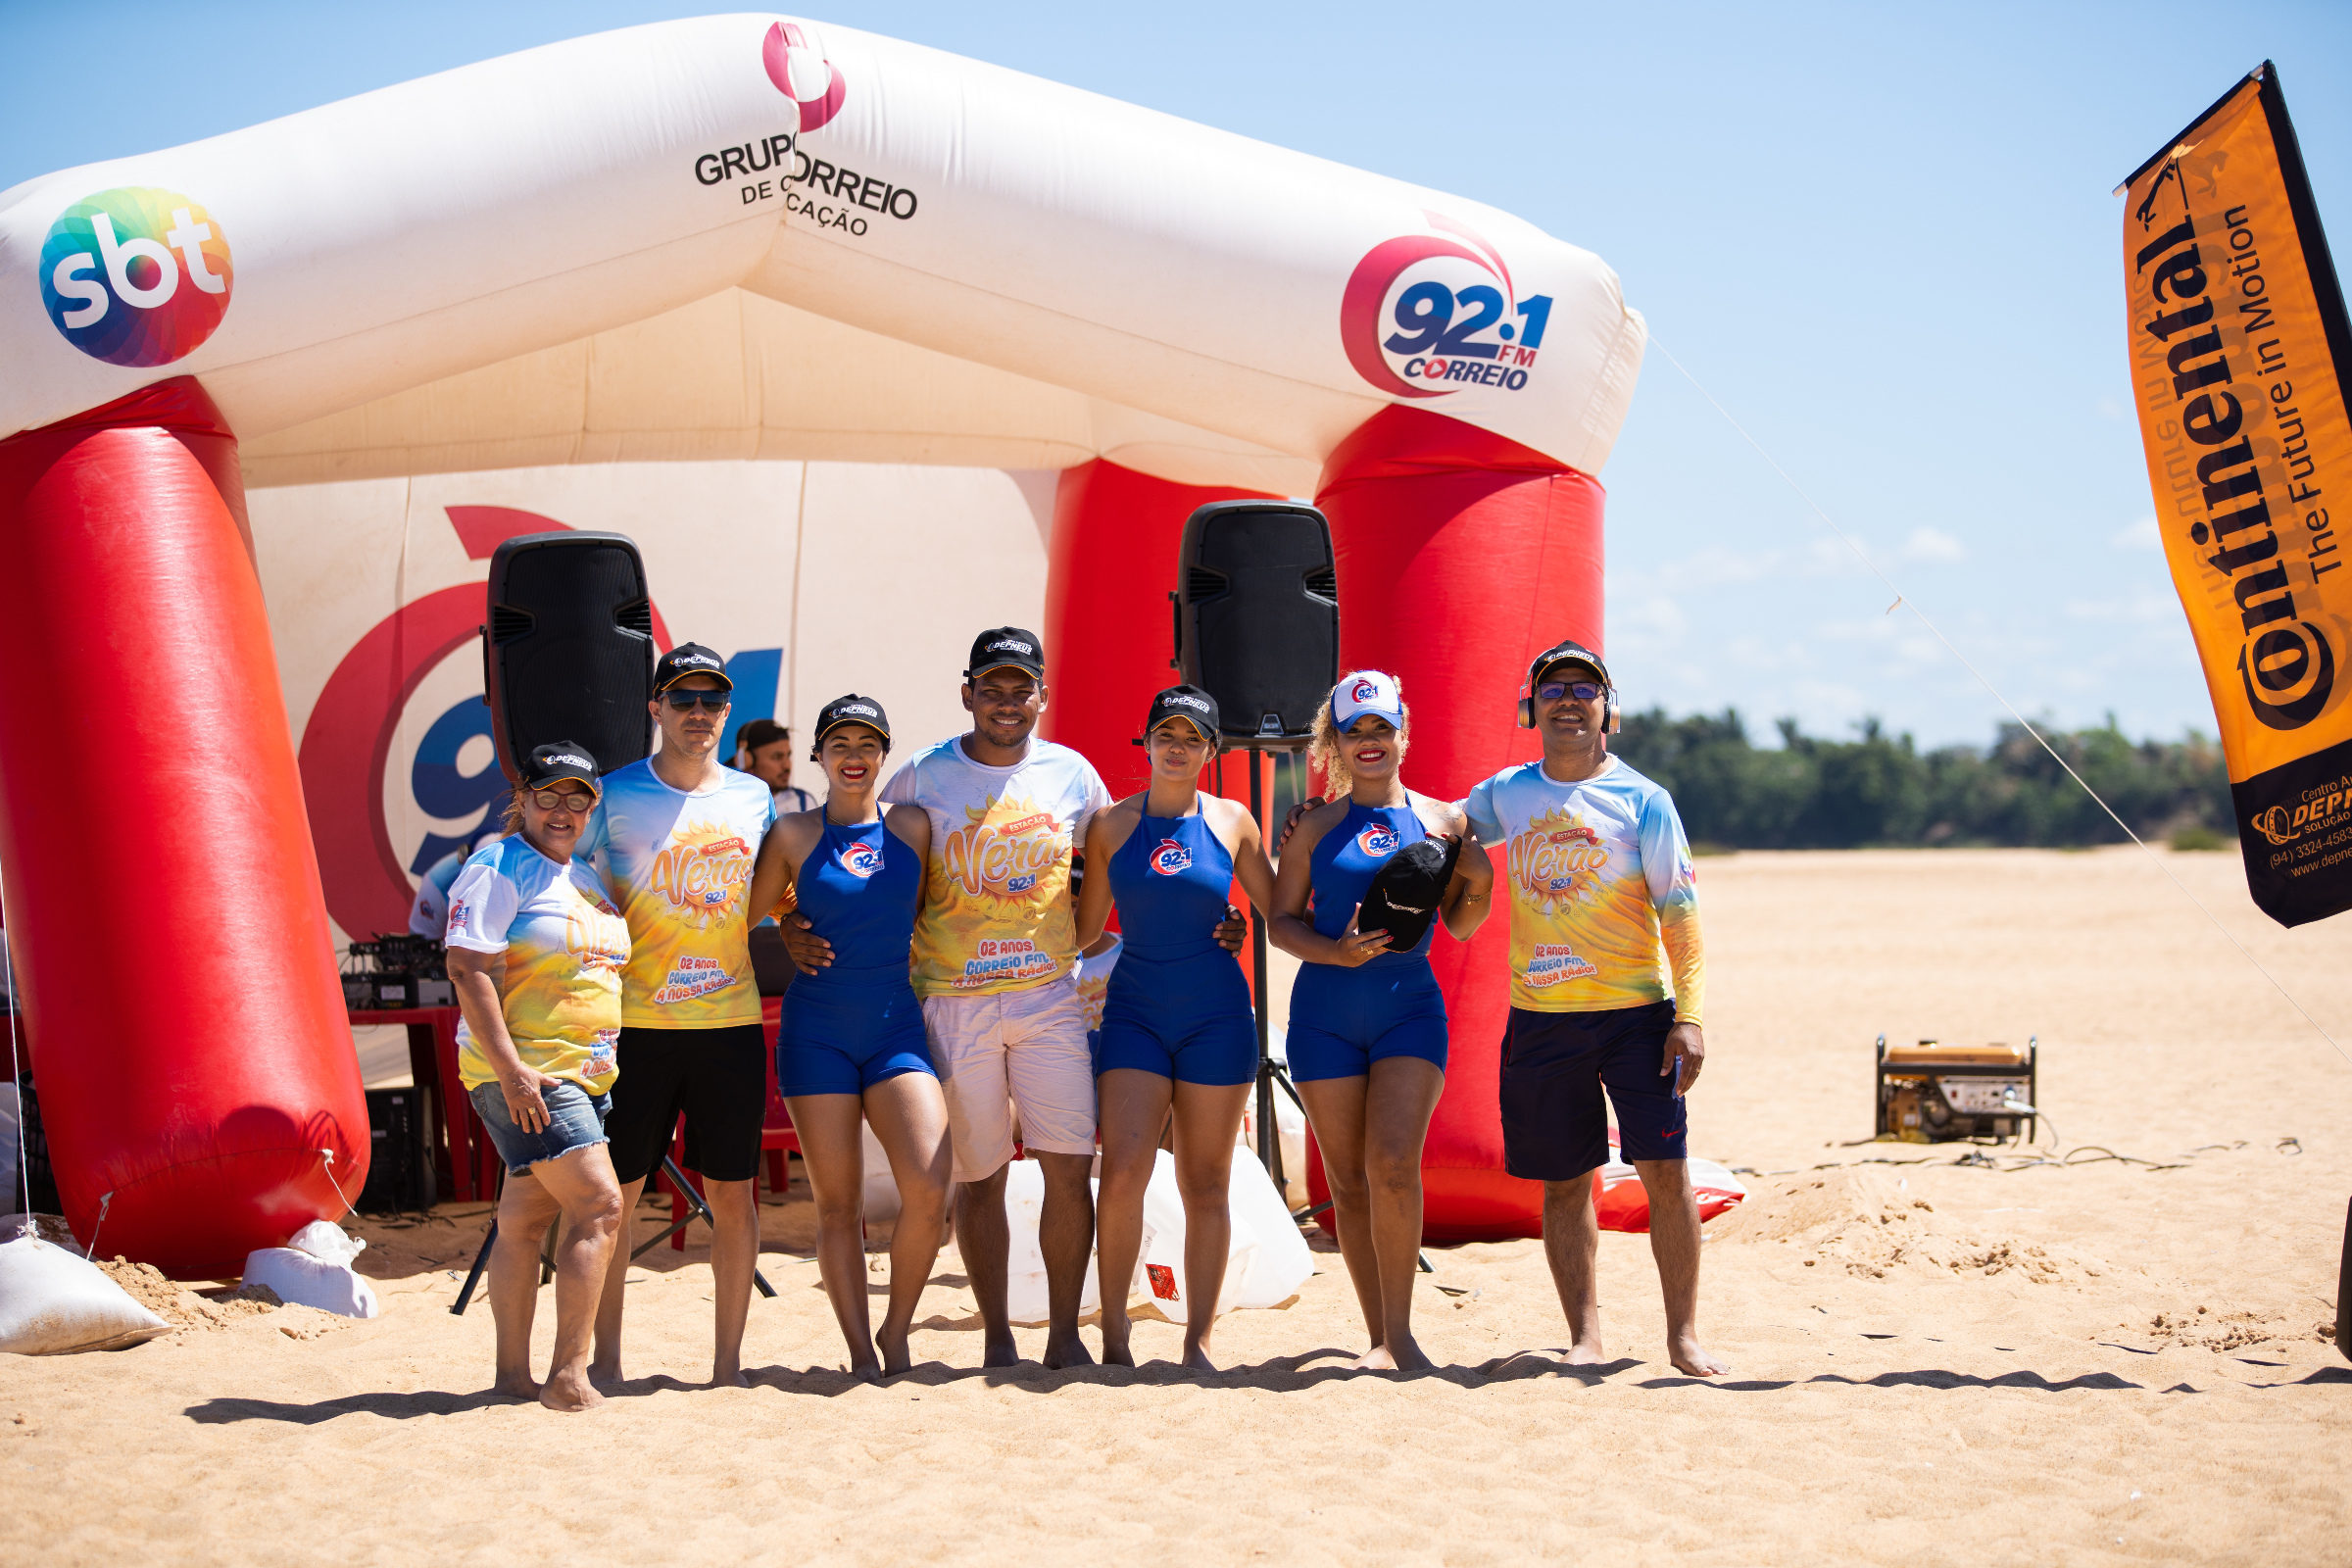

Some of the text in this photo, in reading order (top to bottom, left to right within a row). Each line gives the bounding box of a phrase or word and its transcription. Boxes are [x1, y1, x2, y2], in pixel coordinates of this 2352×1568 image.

[742, 180, 773, 205] DE
[53, 207, 226, 329] sbt
[1383, 280, 1554, 359] 92.1
[1497, 344, 1538, 368] FM
[1403, 358, 1529, 391] CORREIO
[2224, 204, 2342, 585] The Future in Motion
[2135, 214, 2334, 731] Continental
[2301, 781, 2338, 803] Centro
[1009, 815, 1047, 832] ESTAÇÃO
[708, 840, 740, 852] ESTAÇÃO
[1370, 831, 1398, 850] 92.1
[853, 850, 882, 870] 92.1
[1161, 848, 1191, 867] 92.1
[1510, 834, 1608, 891] Verão
[2269, 849, 2294, 870] (94)
[1007, 874, 1036, 892] 92.1
[1550, 876, 1572, 890] 92.1
[706, 889, 726, 904] 92.1
[980, 941, 998, 956] 02
[680, 956, 693, 969] 02
[657, 989, 665, 1002] A
